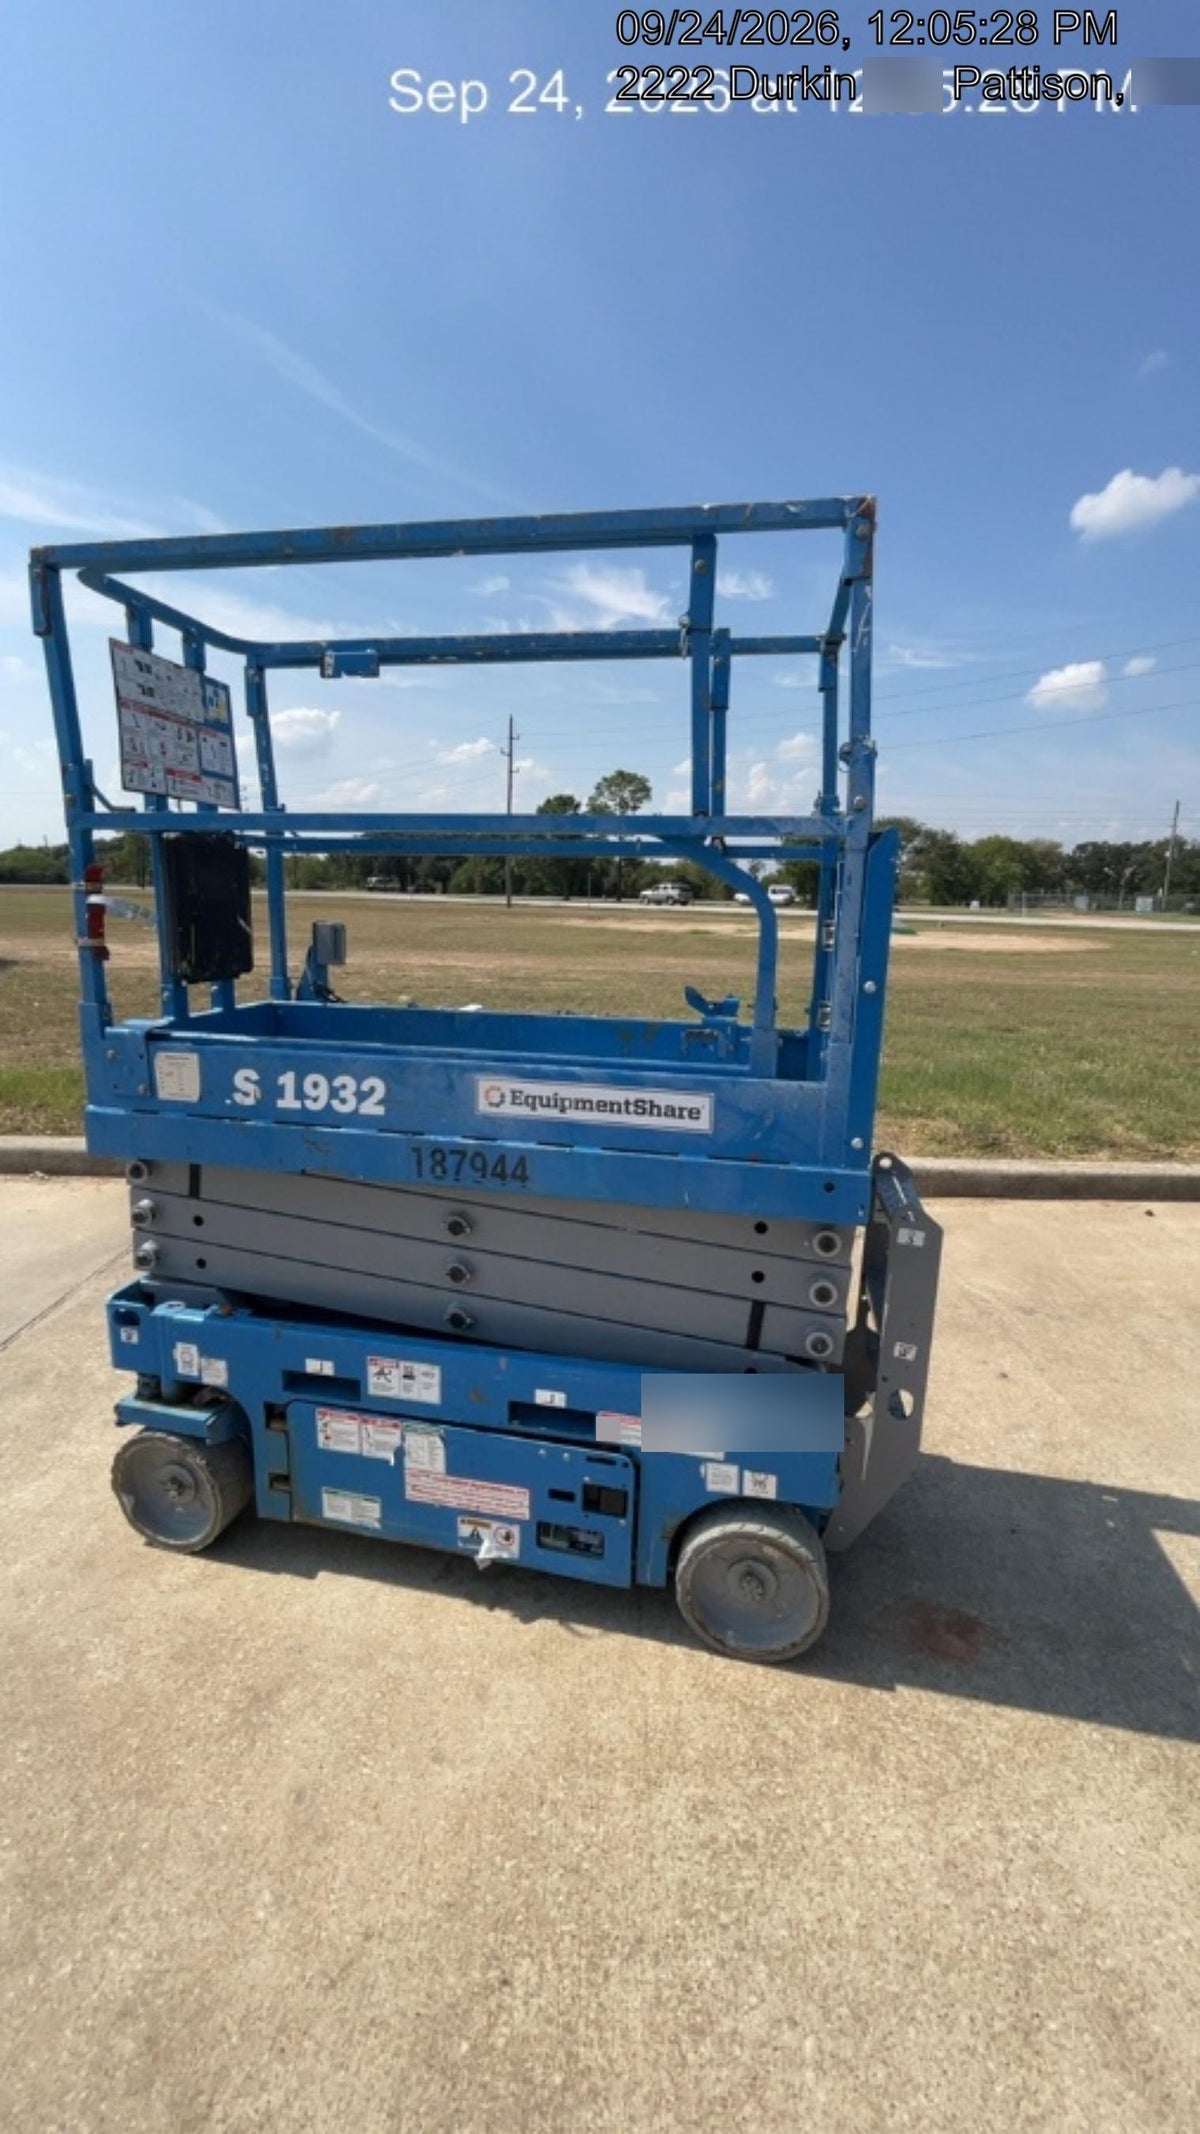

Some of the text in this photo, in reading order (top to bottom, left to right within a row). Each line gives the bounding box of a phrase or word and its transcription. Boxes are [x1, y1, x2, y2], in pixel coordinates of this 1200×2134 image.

[276, 1071, 386, 1115] 1932
[510, 1089, 702, 1121] EquipmentShare
[411, 1147, 530, 1188] 187944
